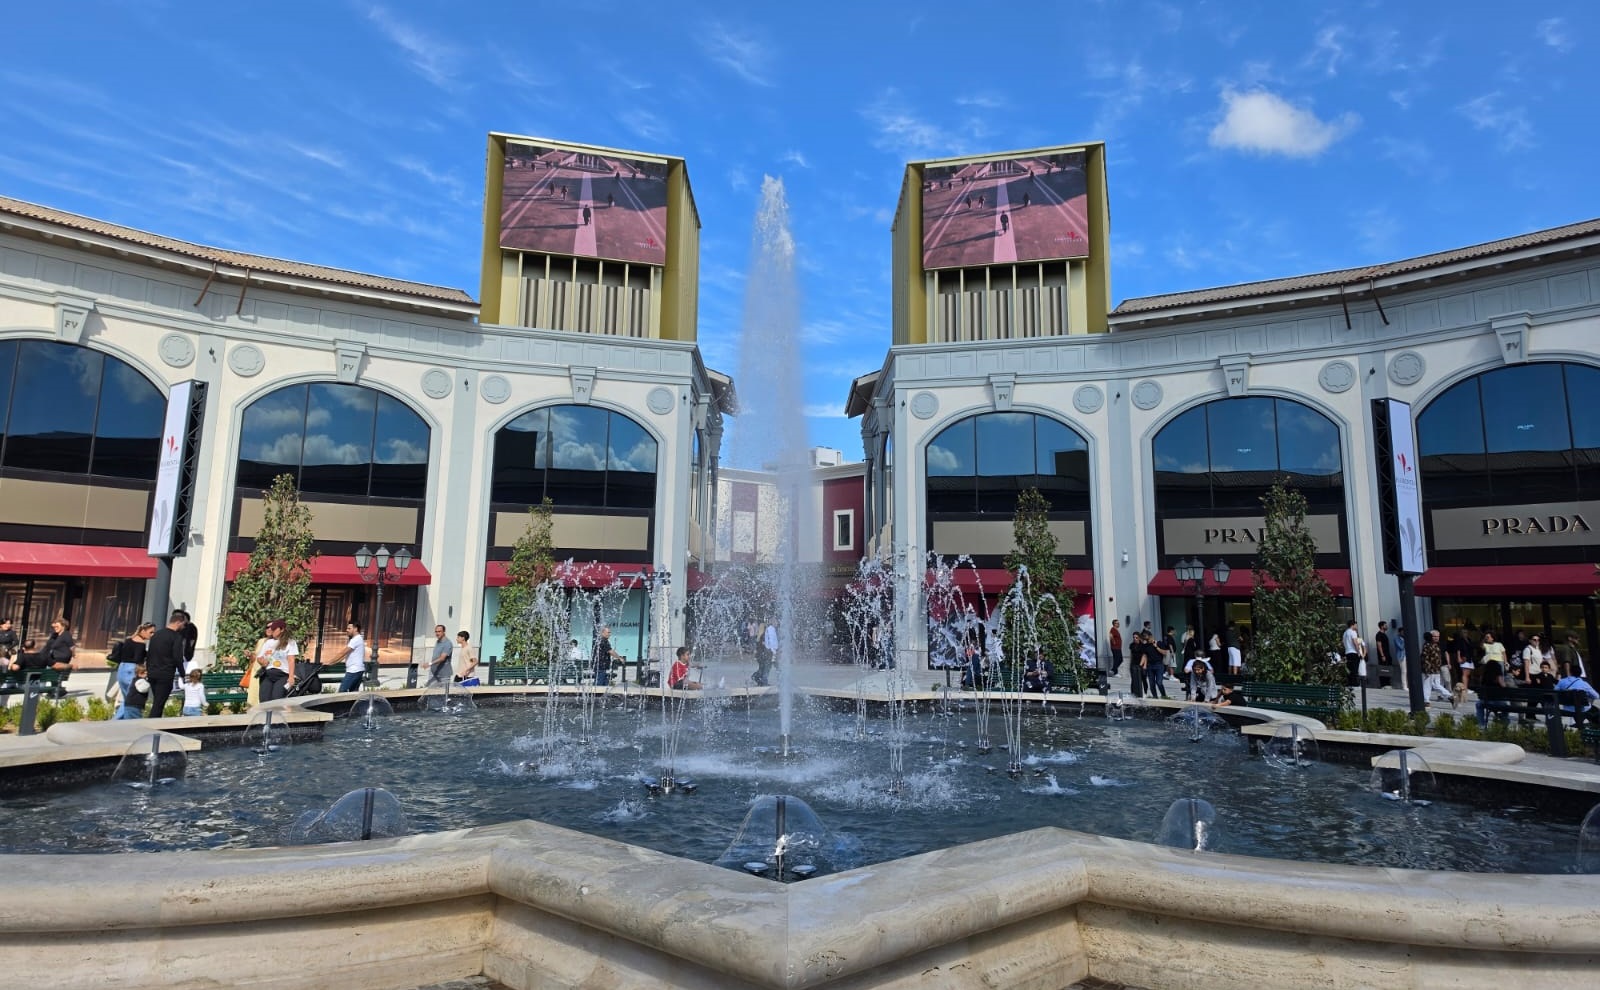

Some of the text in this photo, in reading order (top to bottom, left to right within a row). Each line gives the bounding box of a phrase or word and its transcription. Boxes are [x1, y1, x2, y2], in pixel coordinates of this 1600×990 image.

[64, 320, 78, 329] FV
[1231, 377, 1242, 385] FV
[1482, 514, 1593, 536] PRADA
[1204, 527, 1267, 544] PRA
